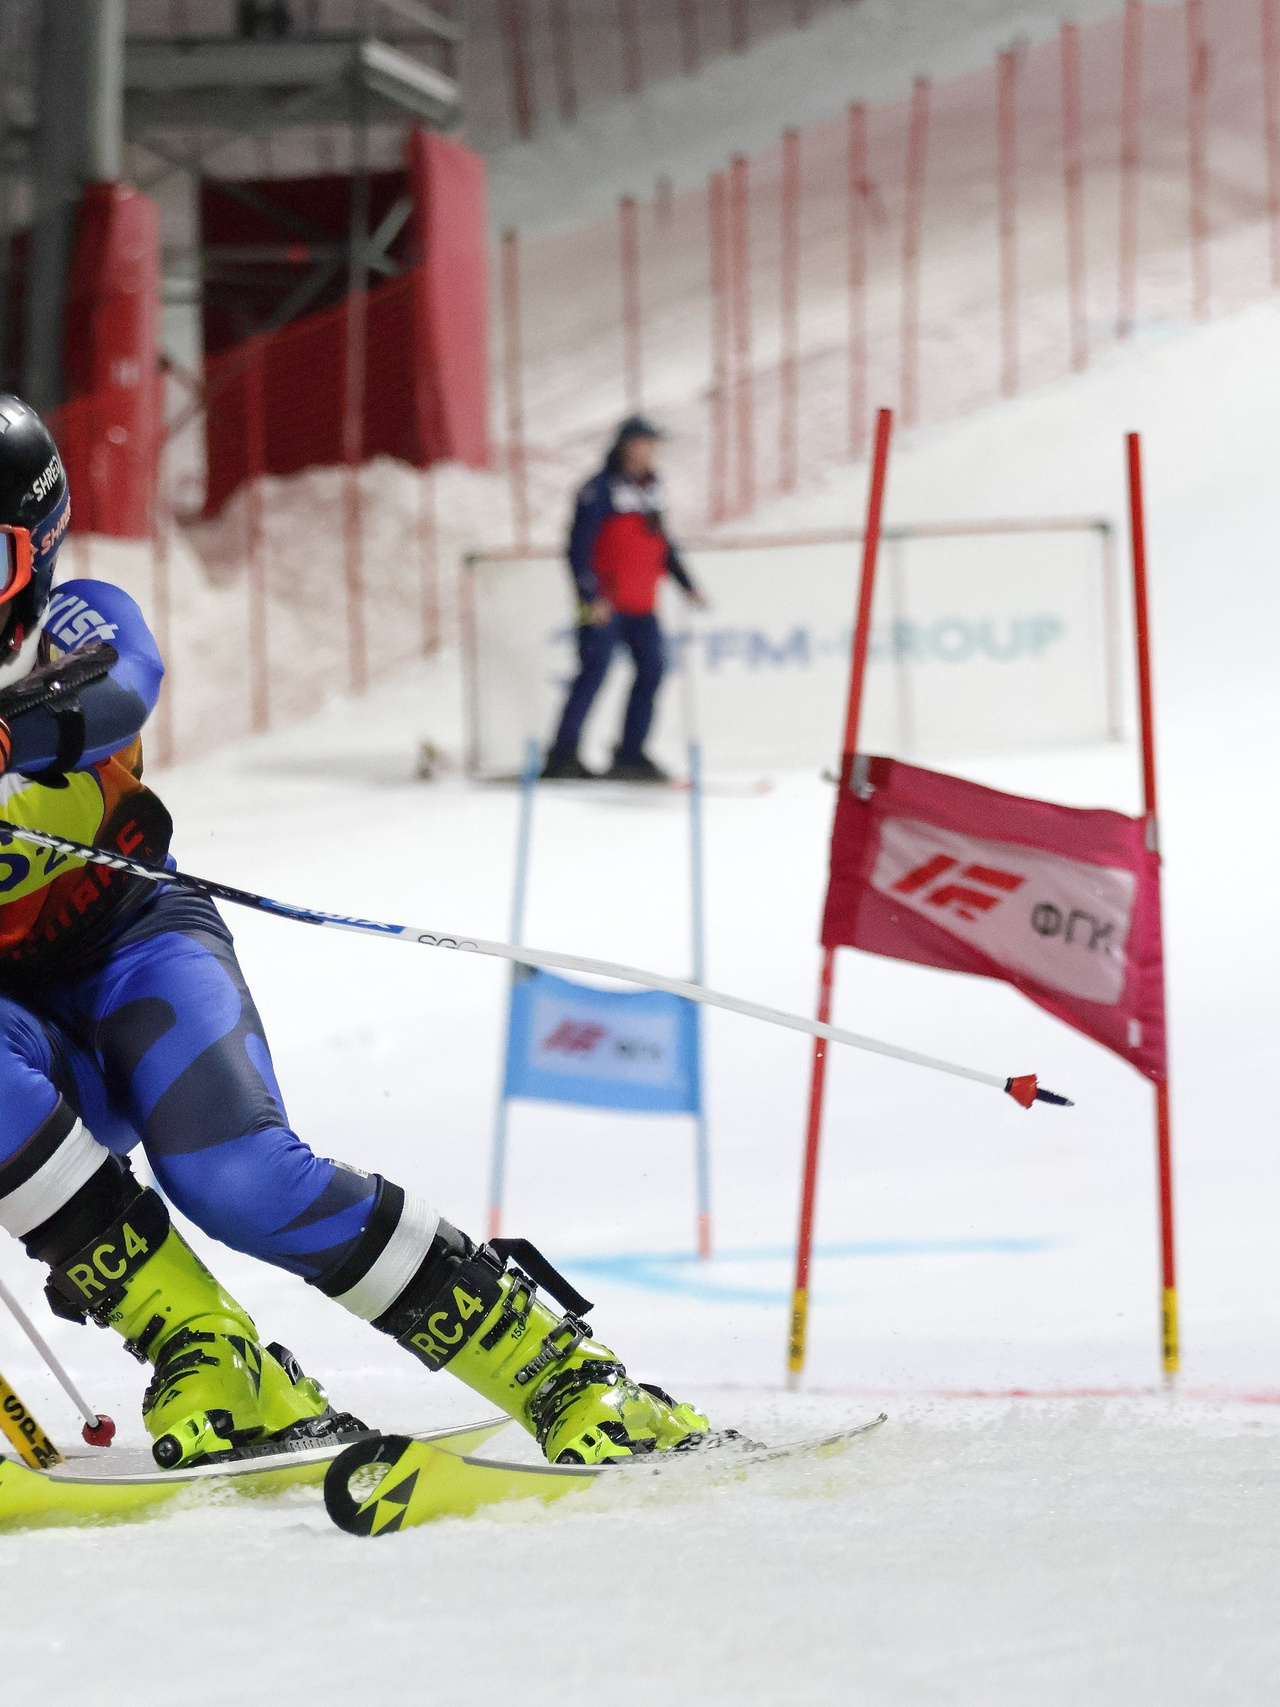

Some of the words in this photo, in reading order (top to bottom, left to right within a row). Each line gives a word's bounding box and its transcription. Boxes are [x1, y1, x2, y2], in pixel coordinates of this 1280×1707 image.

[66, 1222, 149, 1299] RC4
[410, 1284, 484, 1364] RC4
[510, 1323, 526, 1341] 150
[3, 1394, 61, 1470] SPM
